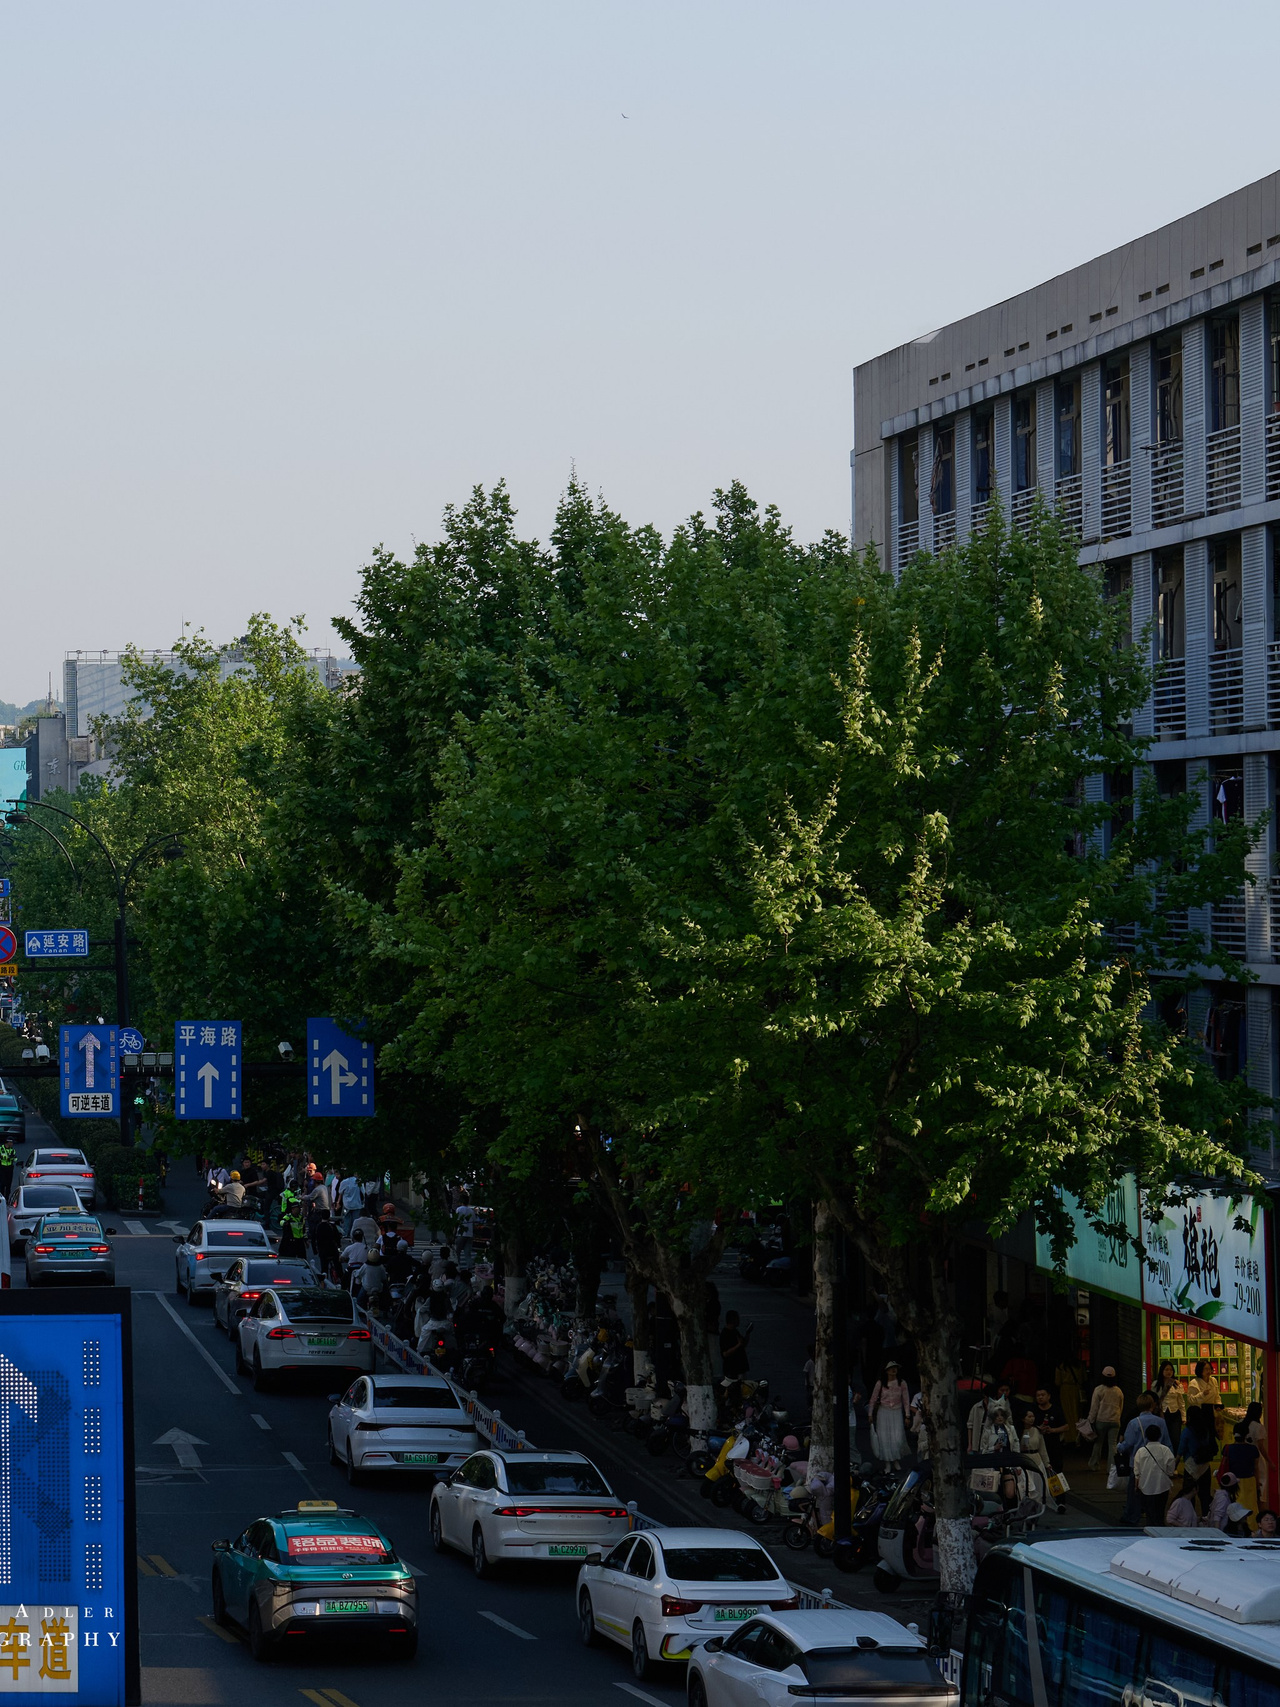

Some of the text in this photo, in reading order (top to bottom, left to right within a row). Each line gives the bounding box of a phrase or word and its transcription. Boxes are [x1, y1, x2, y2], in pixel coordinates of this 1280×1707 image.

[43, 934, 85, 948] 延安路
[179, 1025, 238, 1047] 平海路
[71, 1095, 111, 1111] 可逆车道
[1182, 1205, 1221, 1298] 旗袍
[1234, 1255, 1260, 1283] 平价旗袍
